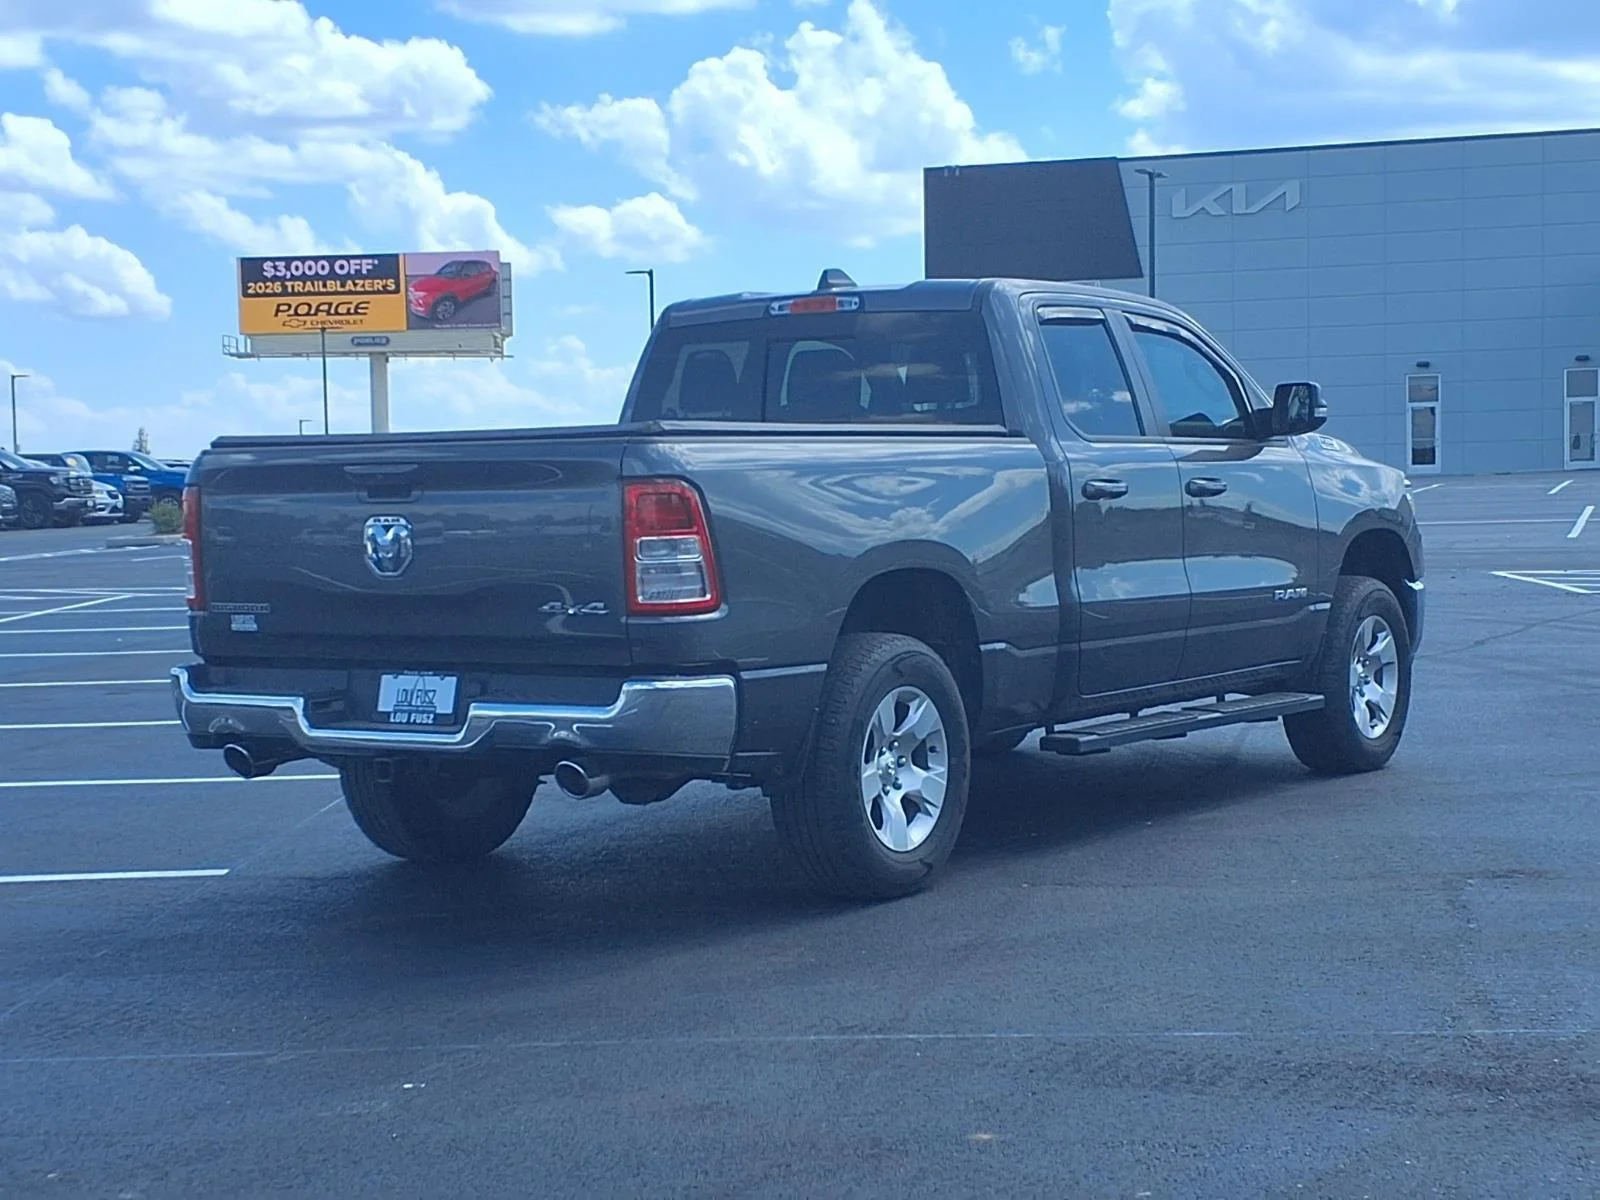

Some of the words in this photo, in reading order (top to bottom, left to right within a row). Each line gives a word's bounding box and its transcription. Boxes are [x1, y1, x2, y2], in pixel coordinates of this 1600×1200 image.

[1172, 179, 1300, 218] KIA
[262, 259, 330, 278] $3,000
[247, 280, 282, 295] 2026
[285, 278, 396, 294] TRAILBLAZER'S
[273, 301, 371, 318] POAGE
[310, 319, 364, 327] CHEVROLET
[1274, 587, 1308, 600] RAM
[390, 712, 408, 723] LOU
[410, 713, 434, 724] FUSZ
